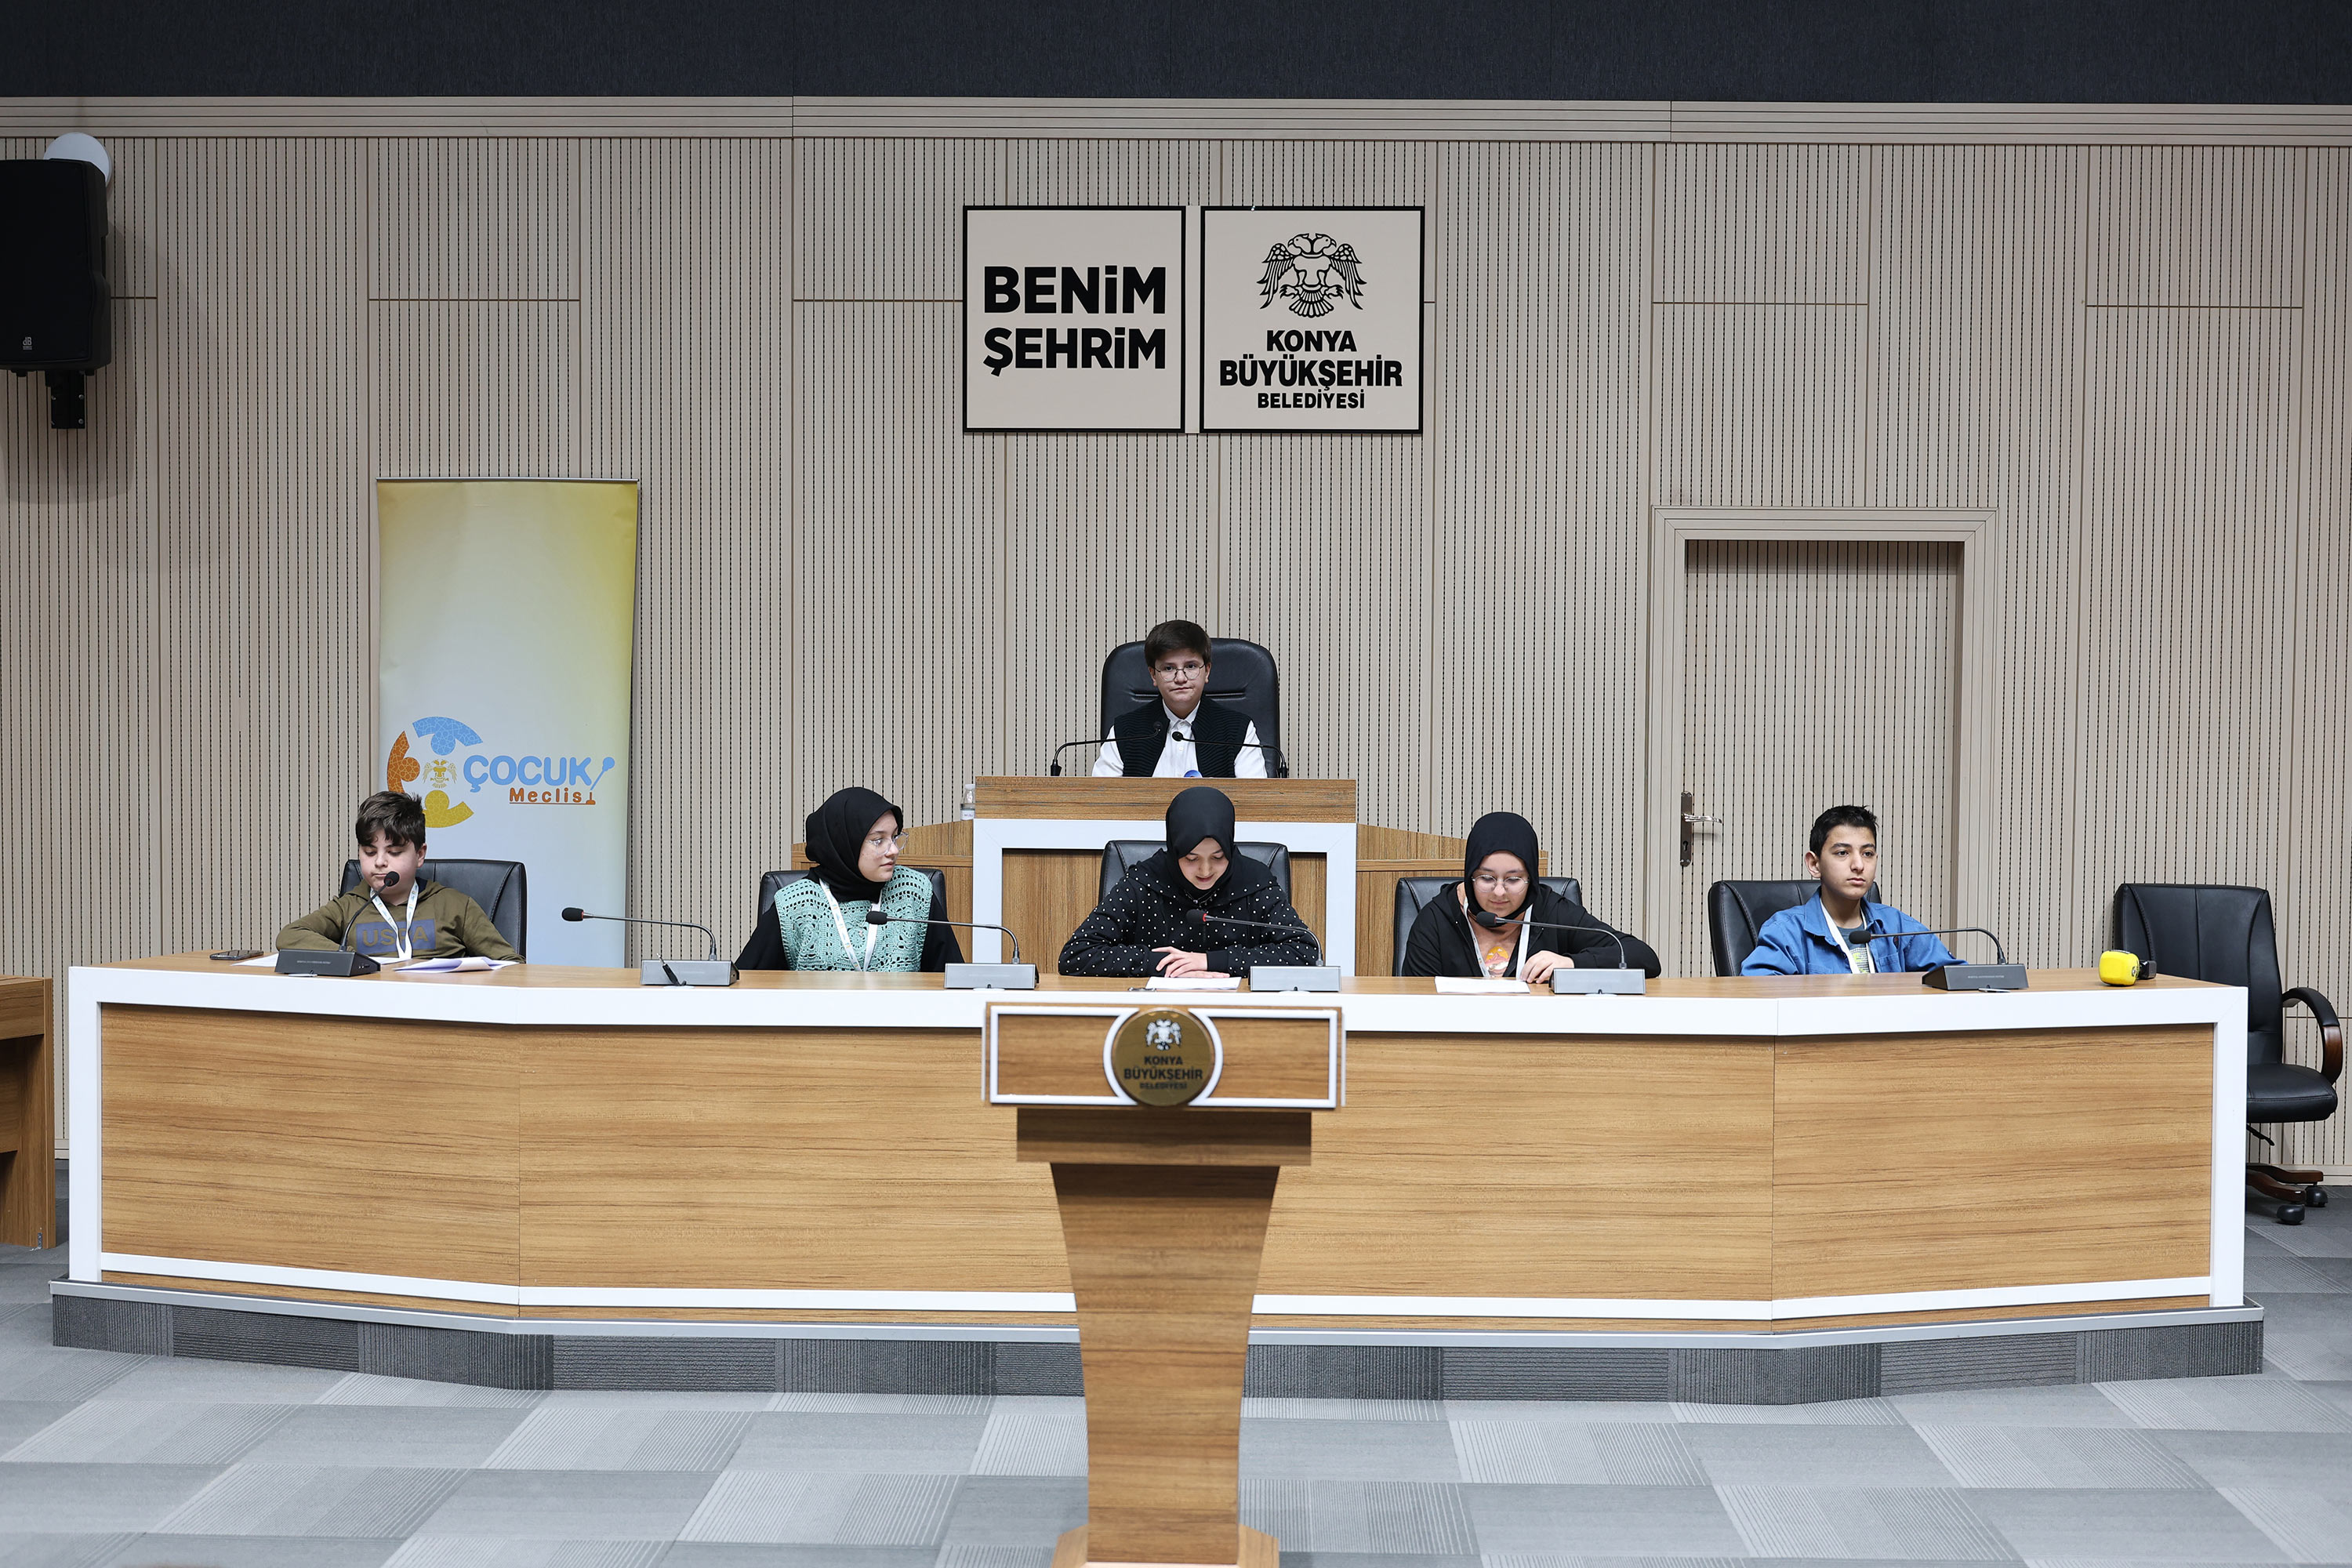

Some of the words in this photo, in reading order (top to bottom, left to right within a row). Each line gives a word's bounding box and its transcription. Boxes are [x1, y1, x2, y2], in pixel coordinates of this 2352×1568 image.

[984, 265, 1166, 314] BENİM
[982, 326, 1166, 377] ŞEHRİM
[1266, 329, 1357, 352] KONYA
[1220, 354, 1403, 391] BÜYÜKŞEHİR
[1258, 389, 1365, 408] BELEDİYESİ
[463, 754, 592, 793] ÇOCUK
[1144, 1055, 1183, 1065] KONYA
